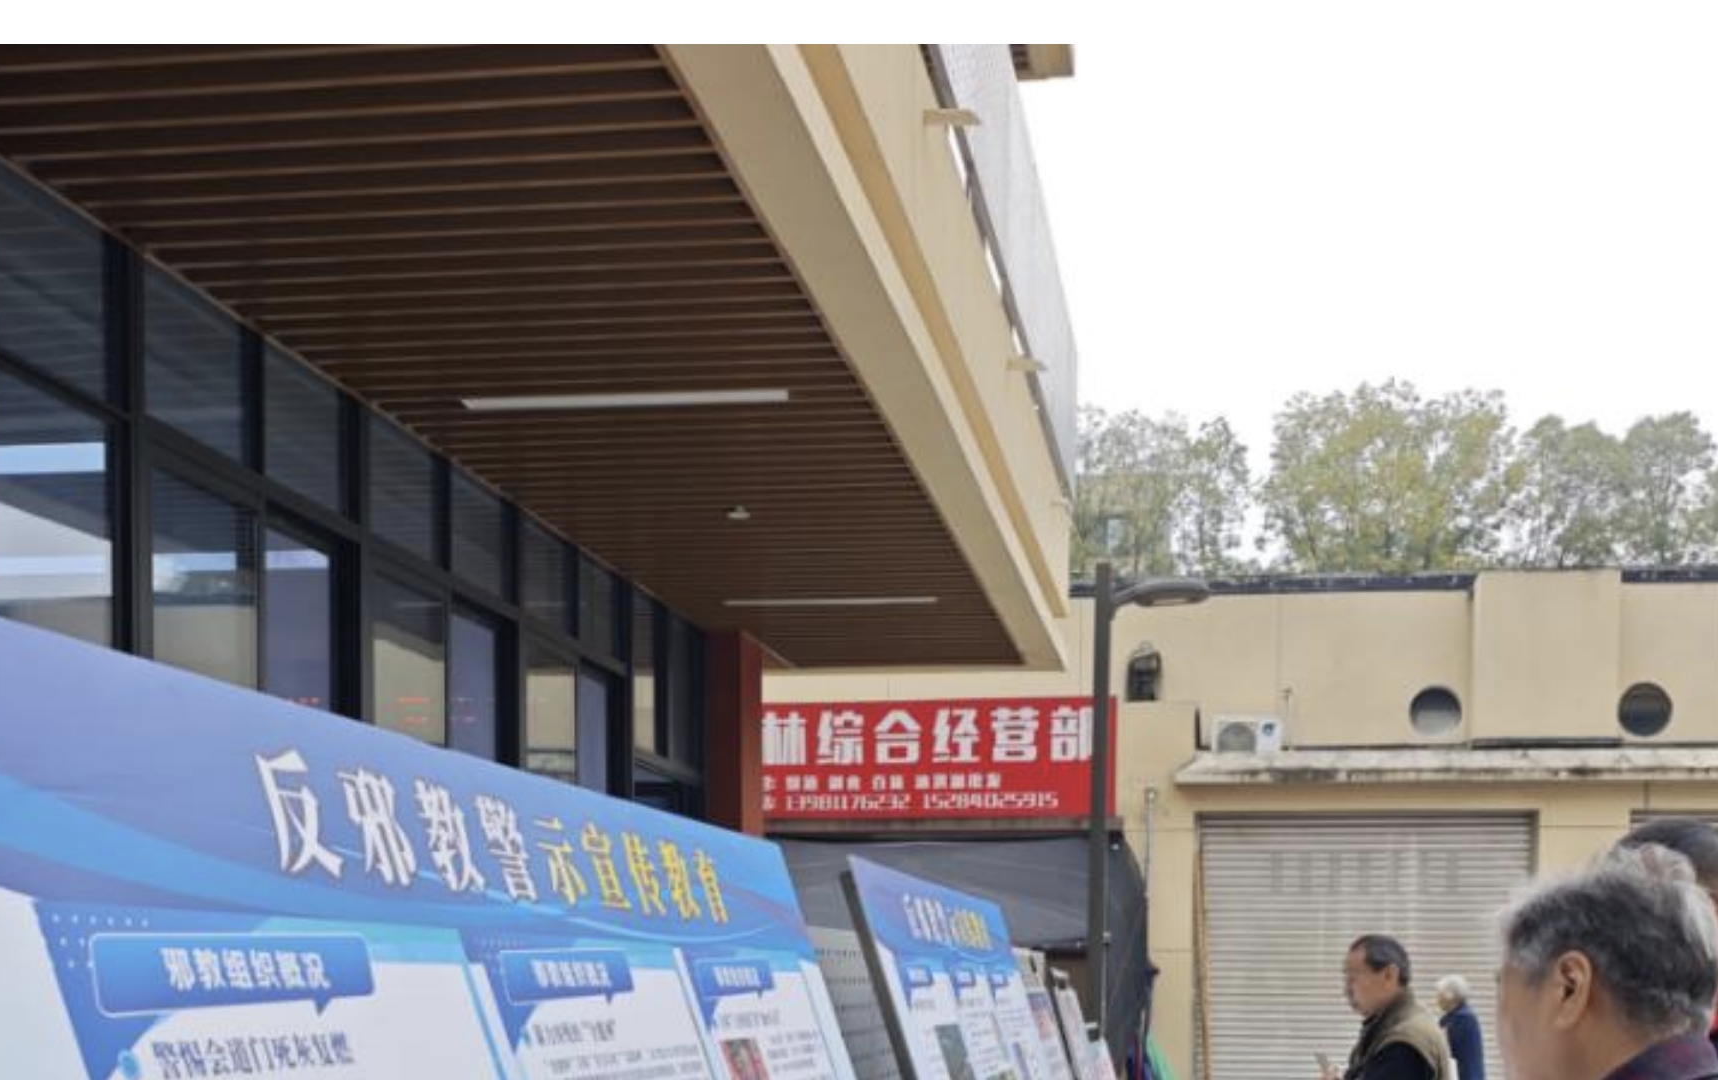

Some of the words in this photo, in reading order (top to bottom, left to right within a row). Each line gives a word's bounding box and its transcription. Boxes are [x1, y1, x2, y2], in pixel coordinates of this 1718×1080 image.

[256, 748, 729, 924] 反邪教警示宣传教育
[159, 946, 331, 991] 邪教组织概况
[152, 1030, 355, 1080] 警惕会道门死灰复燃
